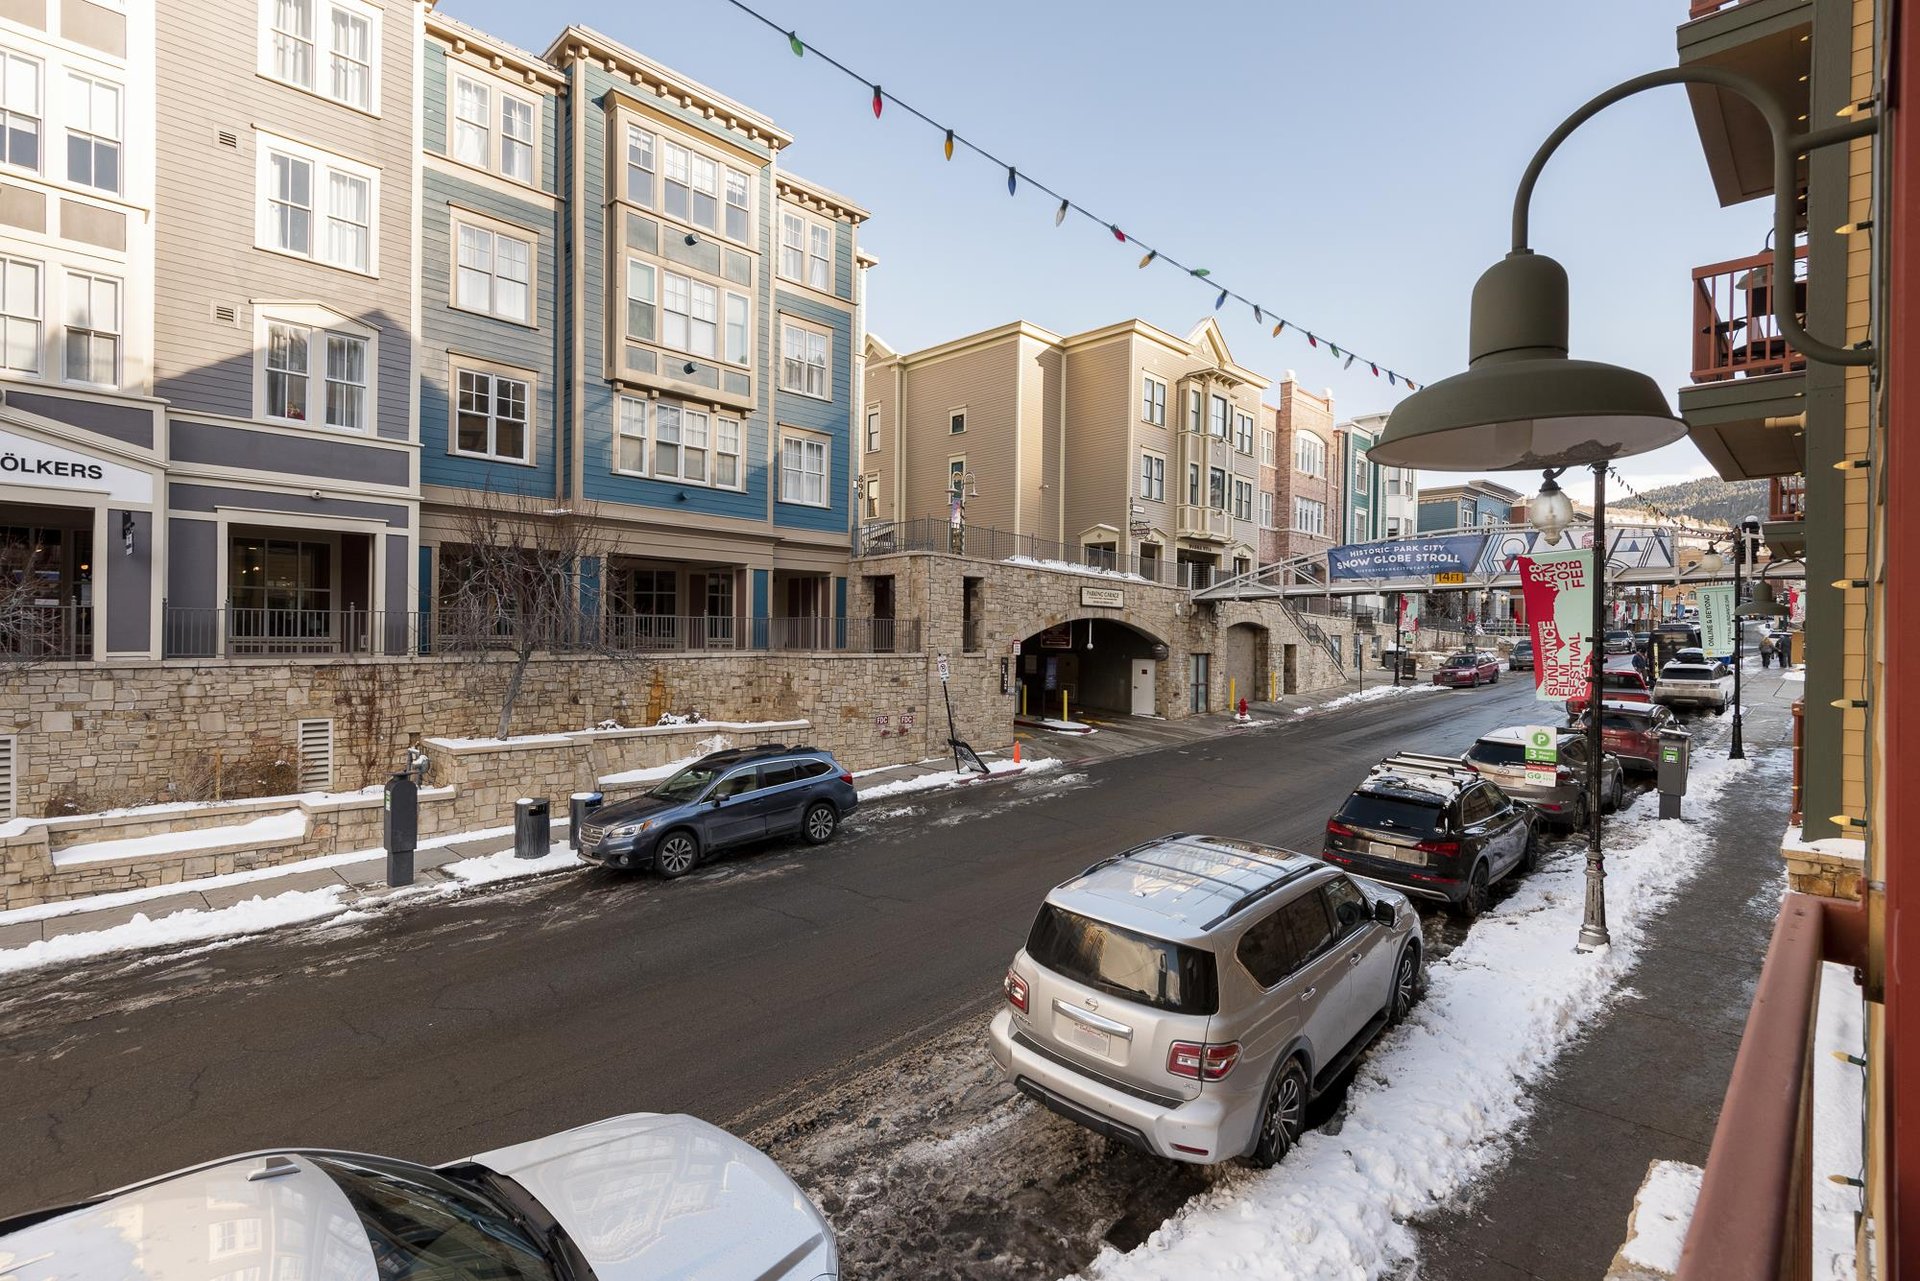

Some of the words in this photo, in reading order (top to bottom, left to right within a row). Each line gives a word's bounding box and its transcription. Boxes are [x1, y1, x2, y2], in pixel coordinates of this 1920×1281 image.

[0, 452, 103, 480] ÖLKERS
[1336, 557, 1370, 570] SNOW
[1374, 555, 1411, 564] GLOBE
[1415, 553, 1460, 563] STROLL
[1350, 546, 1390, 557] HISTORIC
[1529, 564, 1543, 582] 28
[1541, 563, 1558, 591] JAN
[1569, 560, 1585, 588] FEB
[1704, 594, 1712, 619] BEYOND
[1543, 620, 1559, 696] SUNDANCE
[1568, 632, 1581, 697] FESTIVAL
[1559, 664, 1570, 696] FILM
[1577, 661, 1591, 697] 2021
[876, 716, 888, 724] FDC
[1537, 734, 1546, 745] P
[1529, 749, 1537, 759] 3
